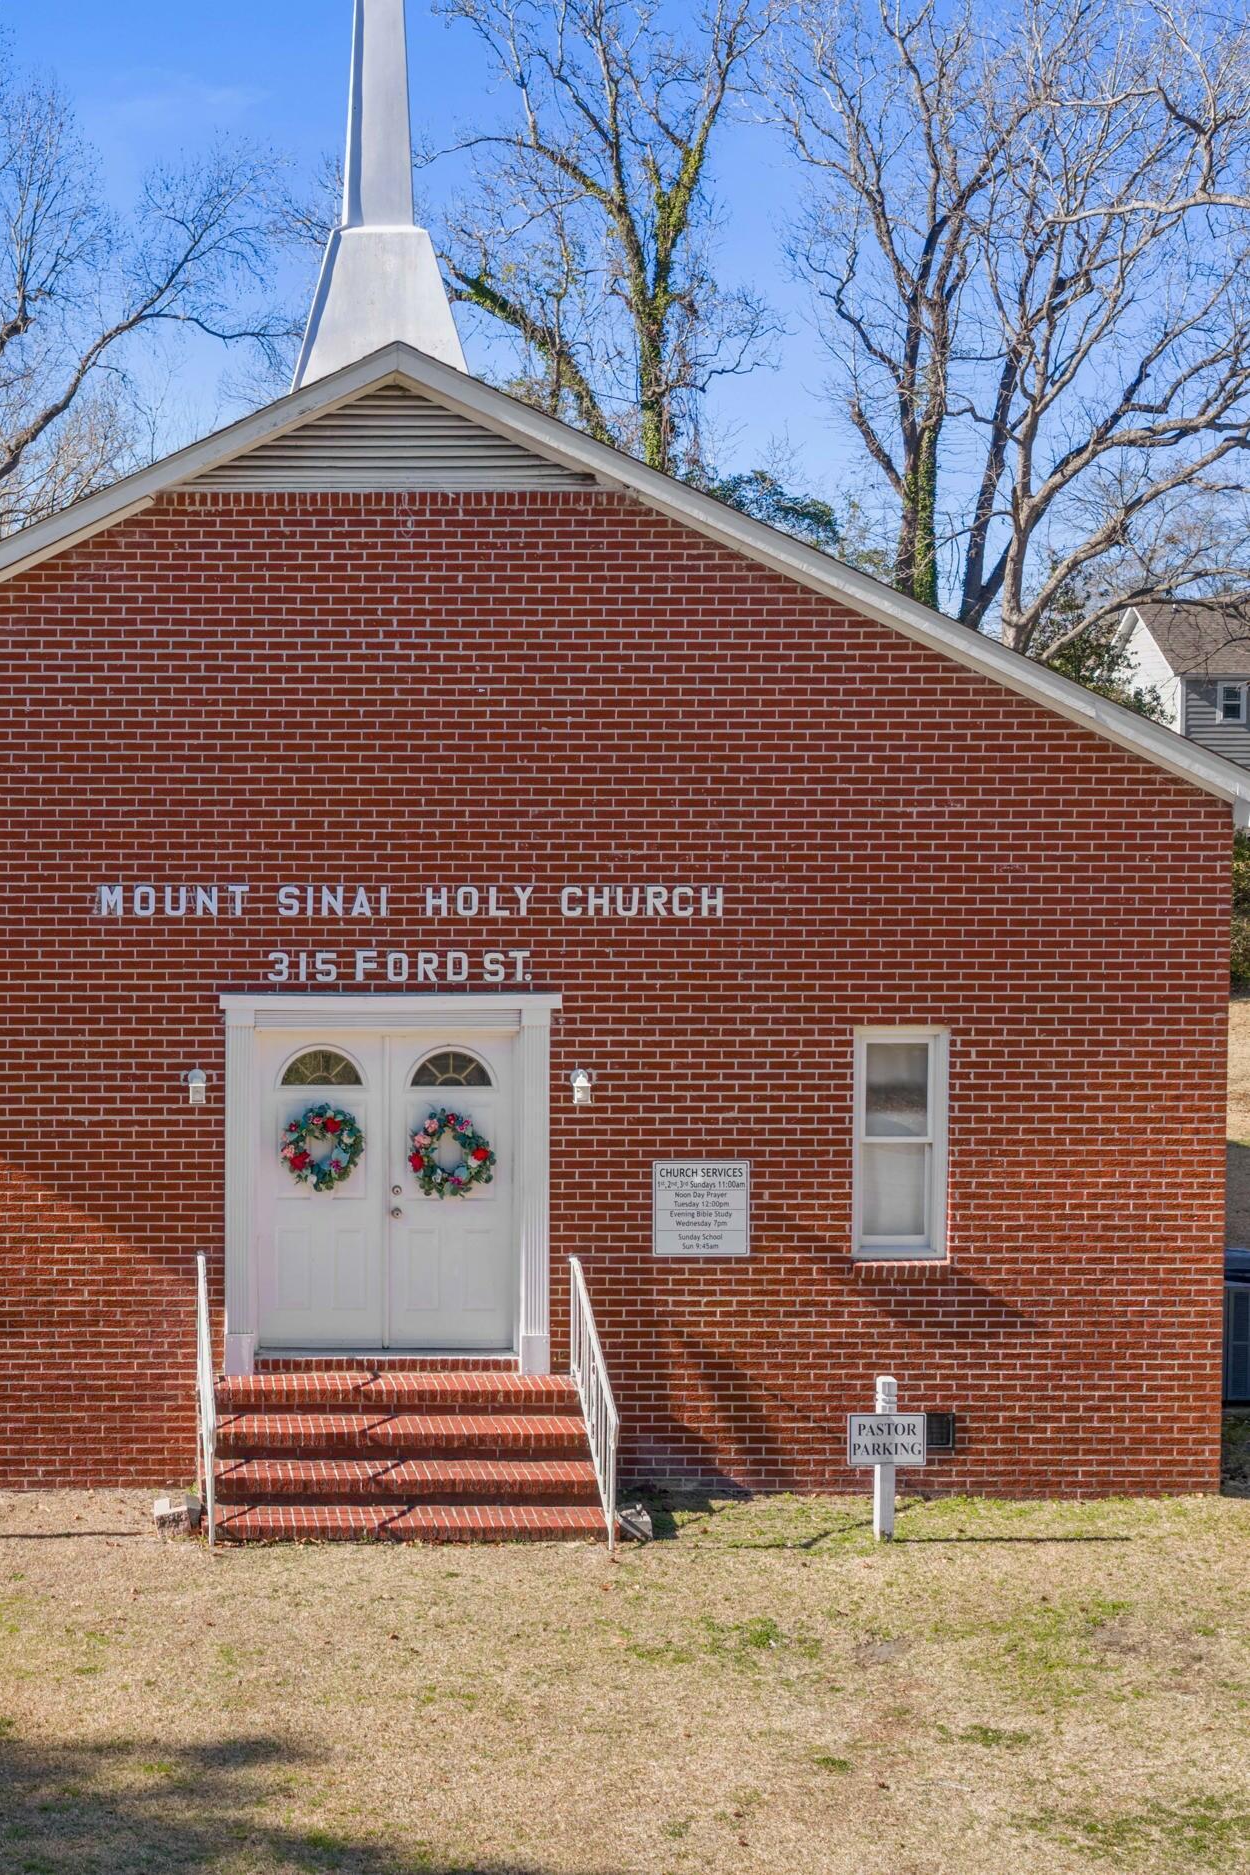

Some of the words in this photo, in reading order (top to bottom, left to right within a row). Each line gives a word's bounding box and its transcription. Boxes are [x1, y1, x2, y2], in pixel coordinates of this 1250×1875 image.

[100, 886, 249, 917] MOUNT
[278, 886, 387, 917] SINAI
[425, 886, 534, 917] HOLY
[561, 886, 724, 917] CHURCH
[267, 951, 337, 982] 315
[355, 950, 469, 982] FORD
[483, 951, 532, 982] ST.
[659, 1168, 698, 1178] CHURCH
[701, 1168, 743, 1178] SERVICES
[690, 1181, 716, 1189] Sundays
[858, 1423, 917, 1436] PASTOR
[853, 1443, 922, 1455] PARKING
